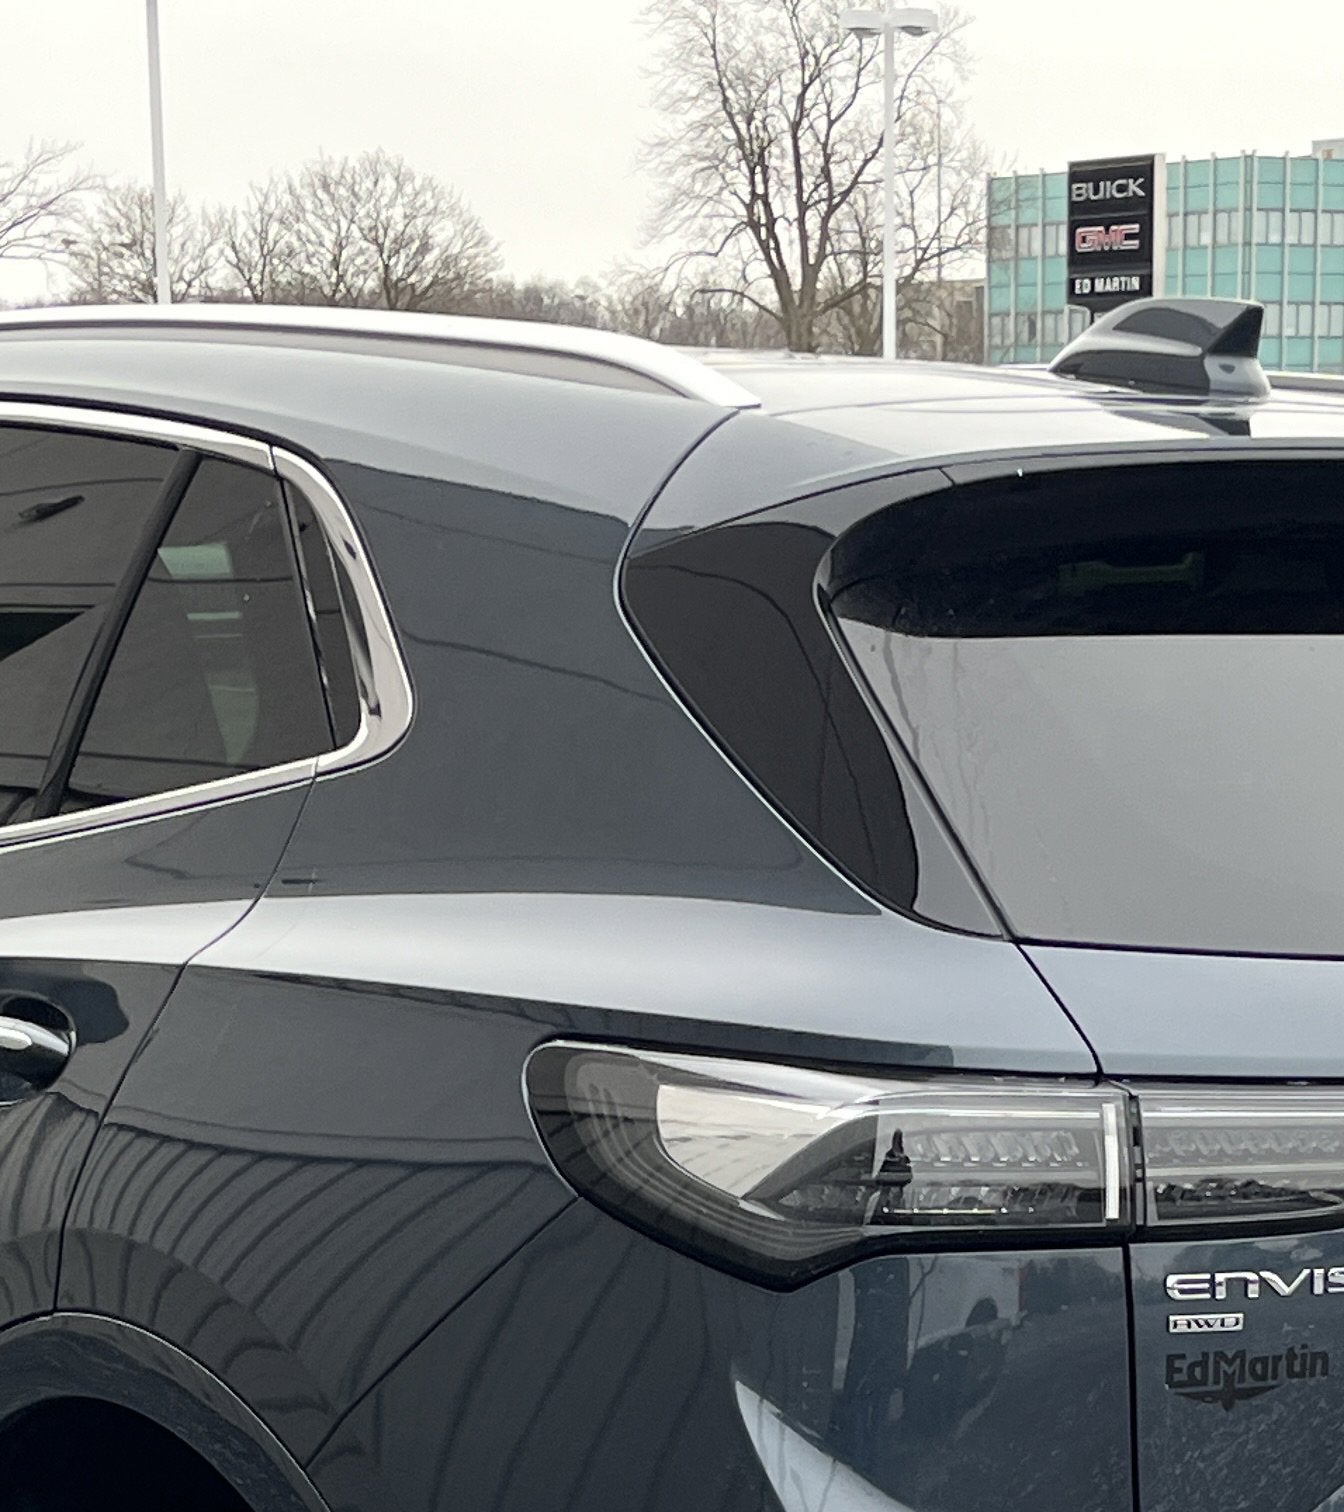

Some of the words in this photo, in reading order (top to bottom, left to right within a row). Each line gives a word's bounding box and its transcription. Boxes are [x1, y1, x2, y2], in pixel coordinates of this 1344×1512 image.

[1071, 178, 1145, 201] BUICK
[1075, 224, 1140, 252] GMC
[1074, 278, 1092, 294] ED
[1094, 276, 1140, 293] MARTIN
[1170, 1315, 1242, 1331] AWD
